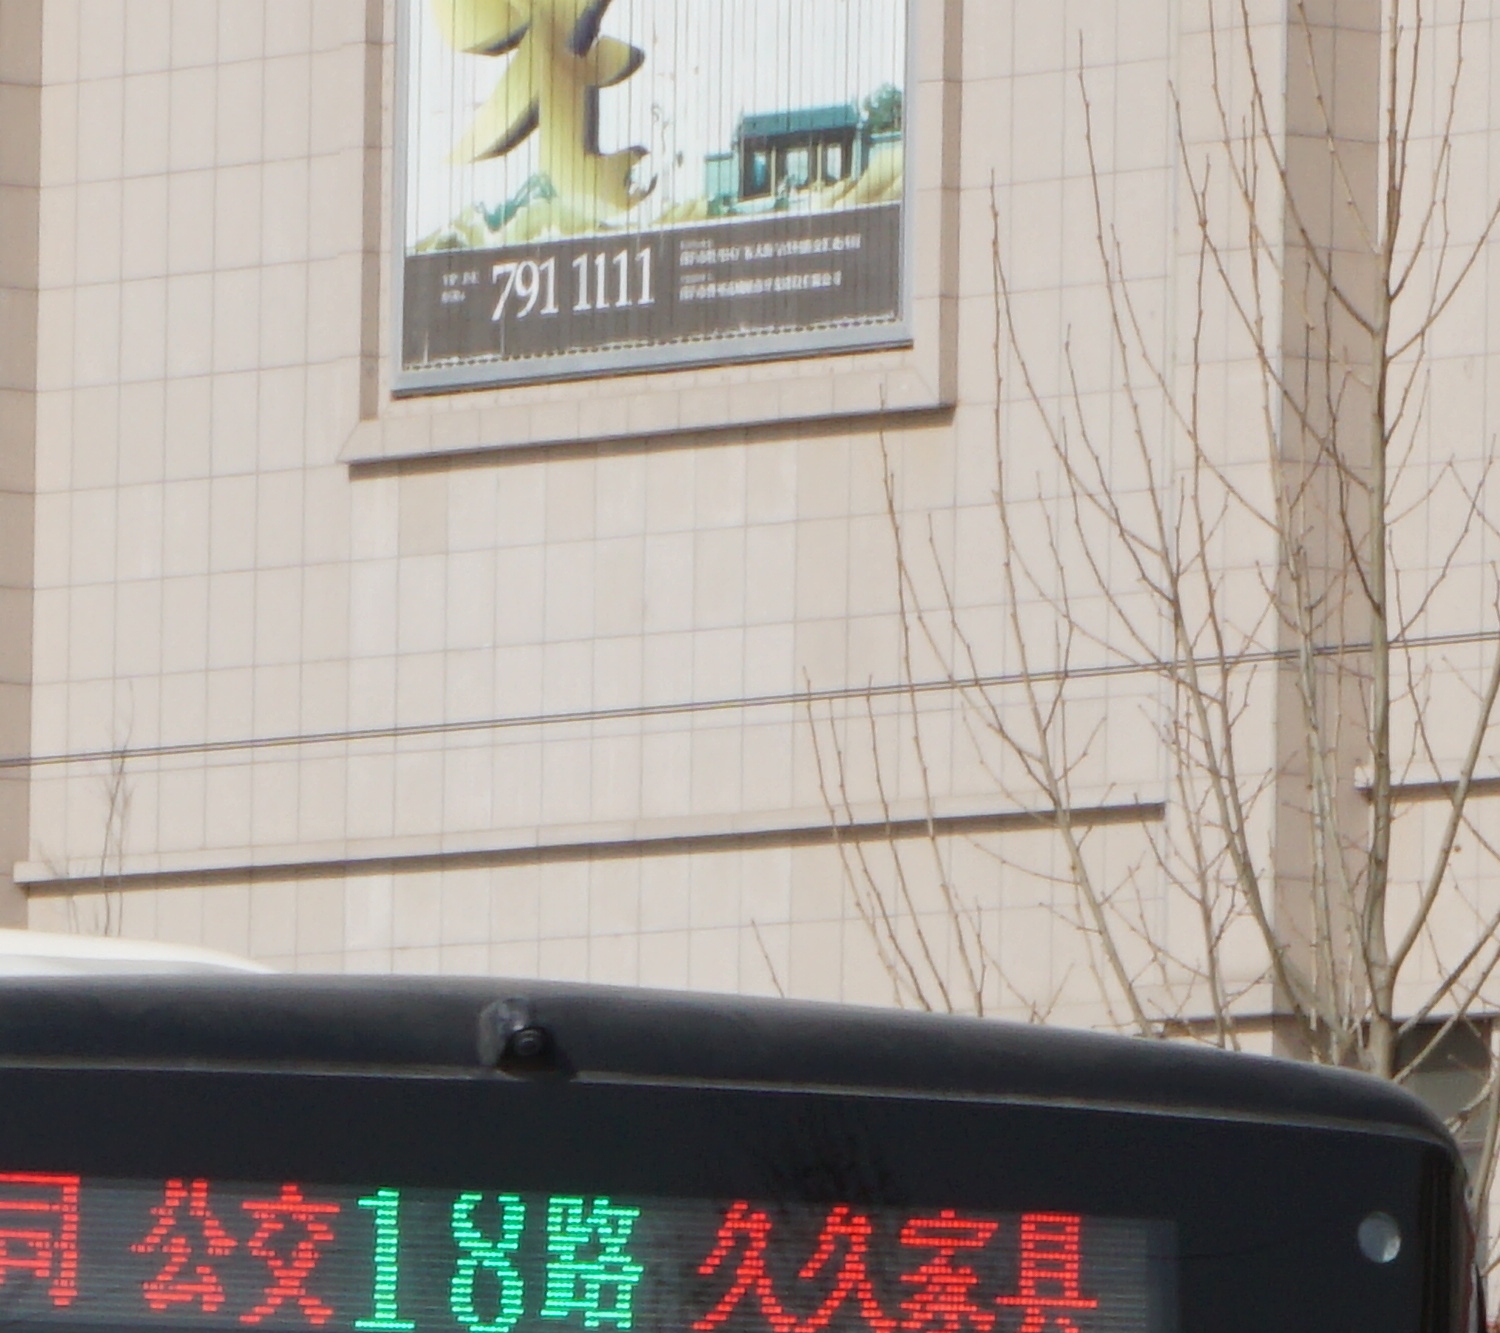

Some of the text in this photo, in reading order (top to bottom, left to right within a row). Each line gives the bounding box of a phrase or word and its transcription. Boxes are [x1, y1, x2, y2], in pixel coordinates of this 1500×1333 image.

[490, 256, 560, 322] 791
[571, 246, 656, 311] 1111
[130, 1176, 342, 1328] 公交
